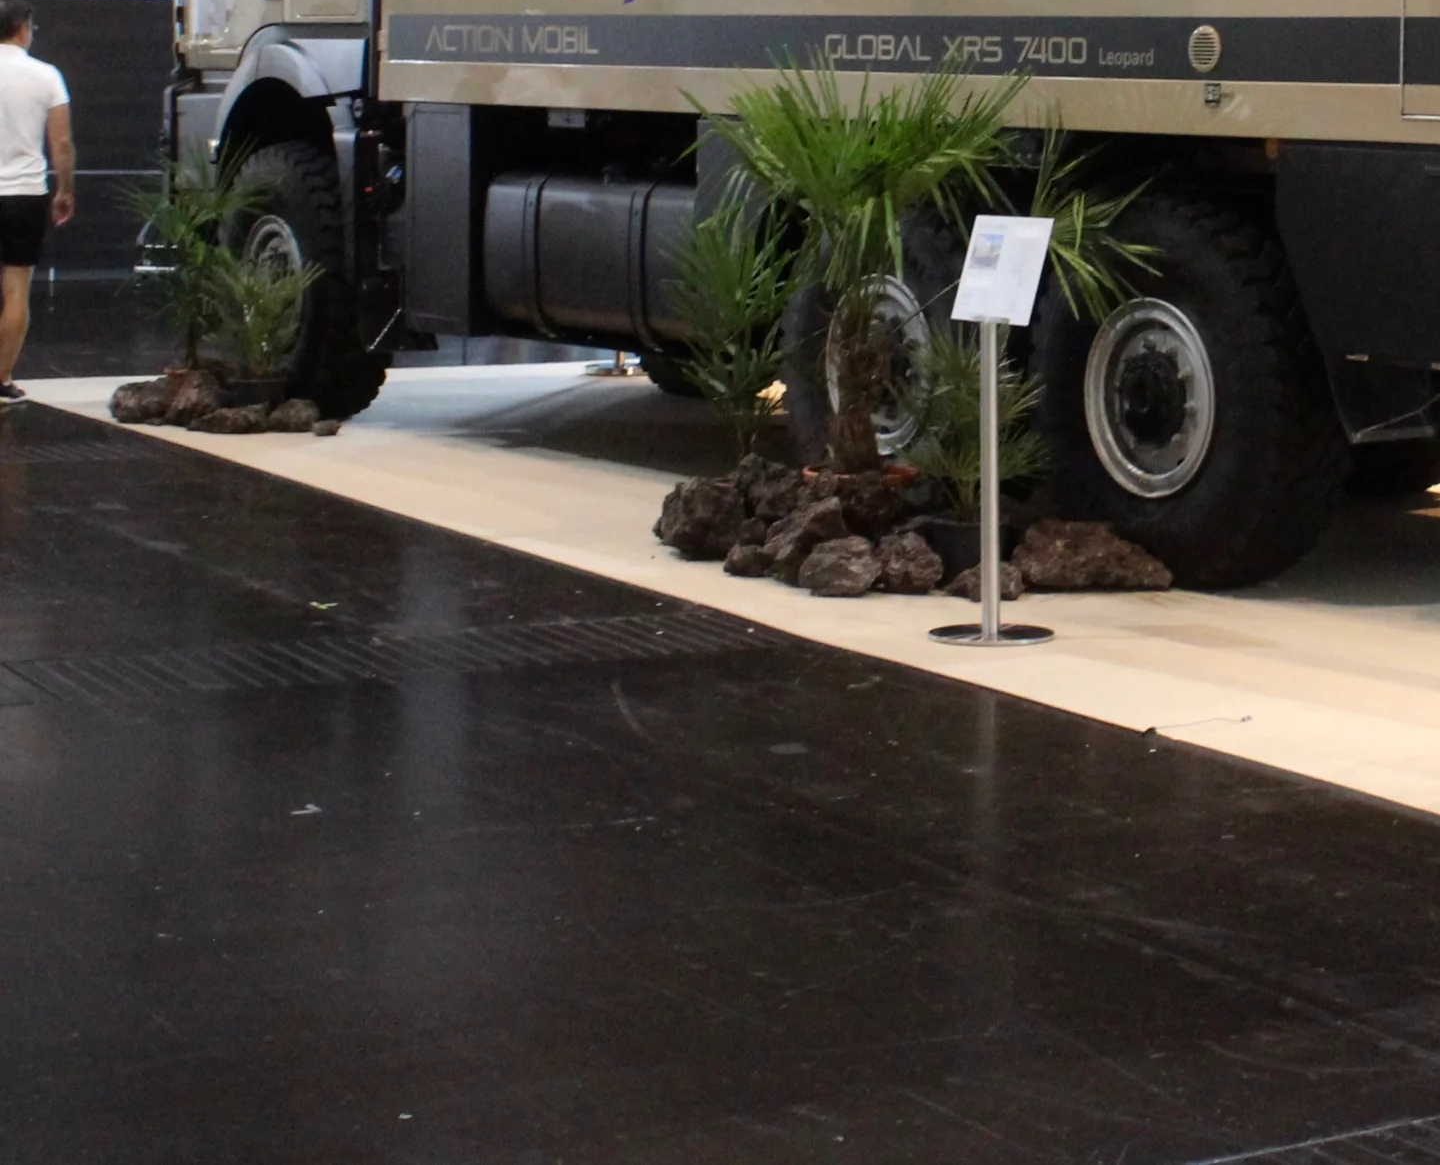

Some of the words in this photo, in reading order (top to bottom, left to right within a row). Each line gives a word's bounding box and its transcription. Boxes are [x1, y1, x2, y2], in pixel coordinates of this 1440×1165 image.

[424, 24, 513, 54] ACTION
[521, 25, 600, 55] MOBIL
[824, 34, 932, 62] GLOBAL
[942, 35, 1004, 64] XRS
[1013, 36, 1089, 65] 7400
[1098, 47, 1155, 68] Leopard
